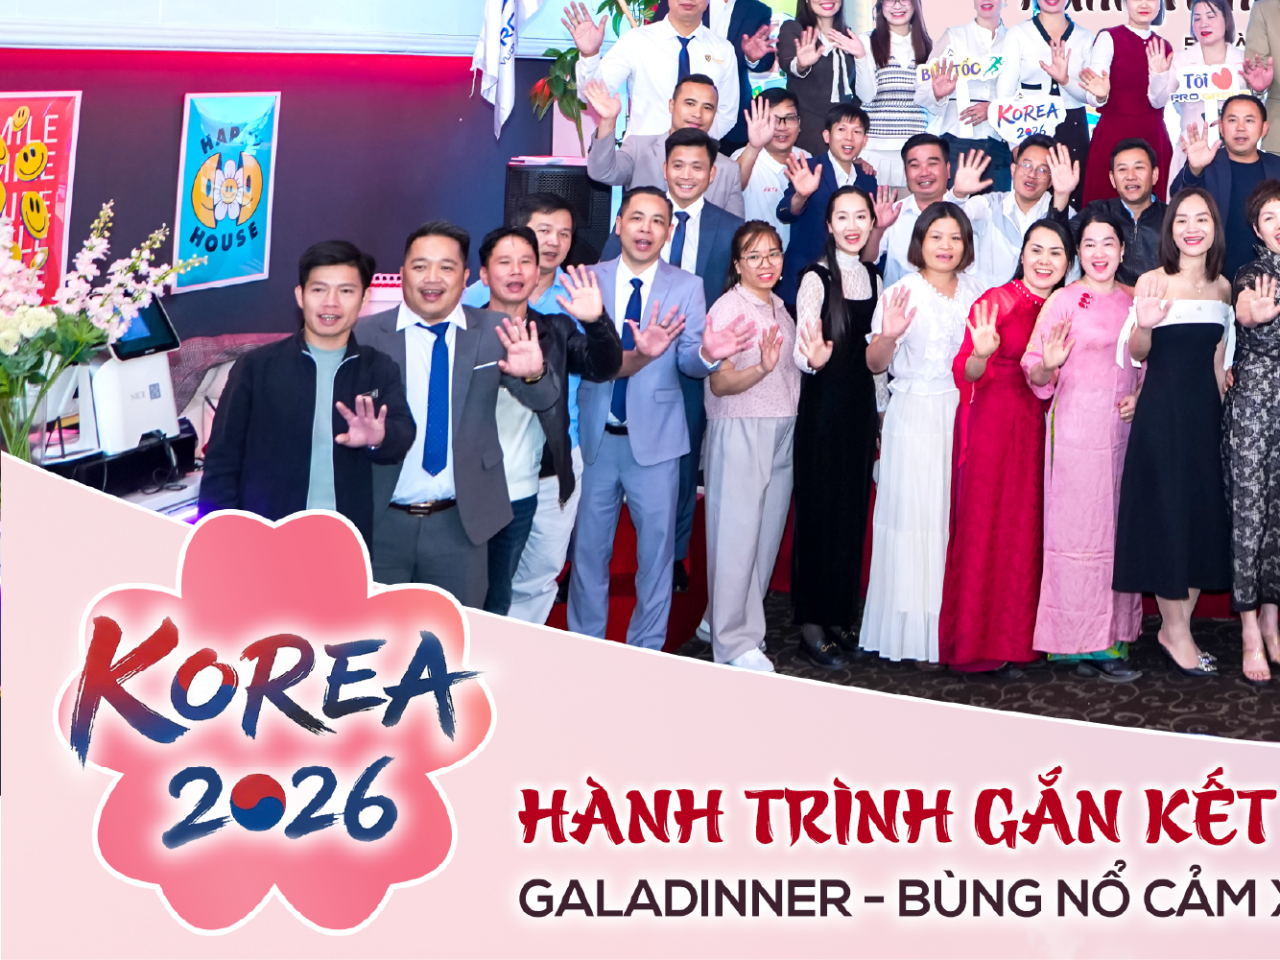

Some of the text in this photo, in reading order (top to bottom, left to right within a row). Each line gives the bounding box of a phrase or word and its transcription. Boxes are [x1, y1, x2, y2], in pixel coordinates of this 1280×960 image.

[1183, 73, 1208, 89] Tôi
[1170, 93, 1199, 101] PRO
[997, 102, 1061, 128] KOREA
[189, 221, 259, 252] HOUSE
